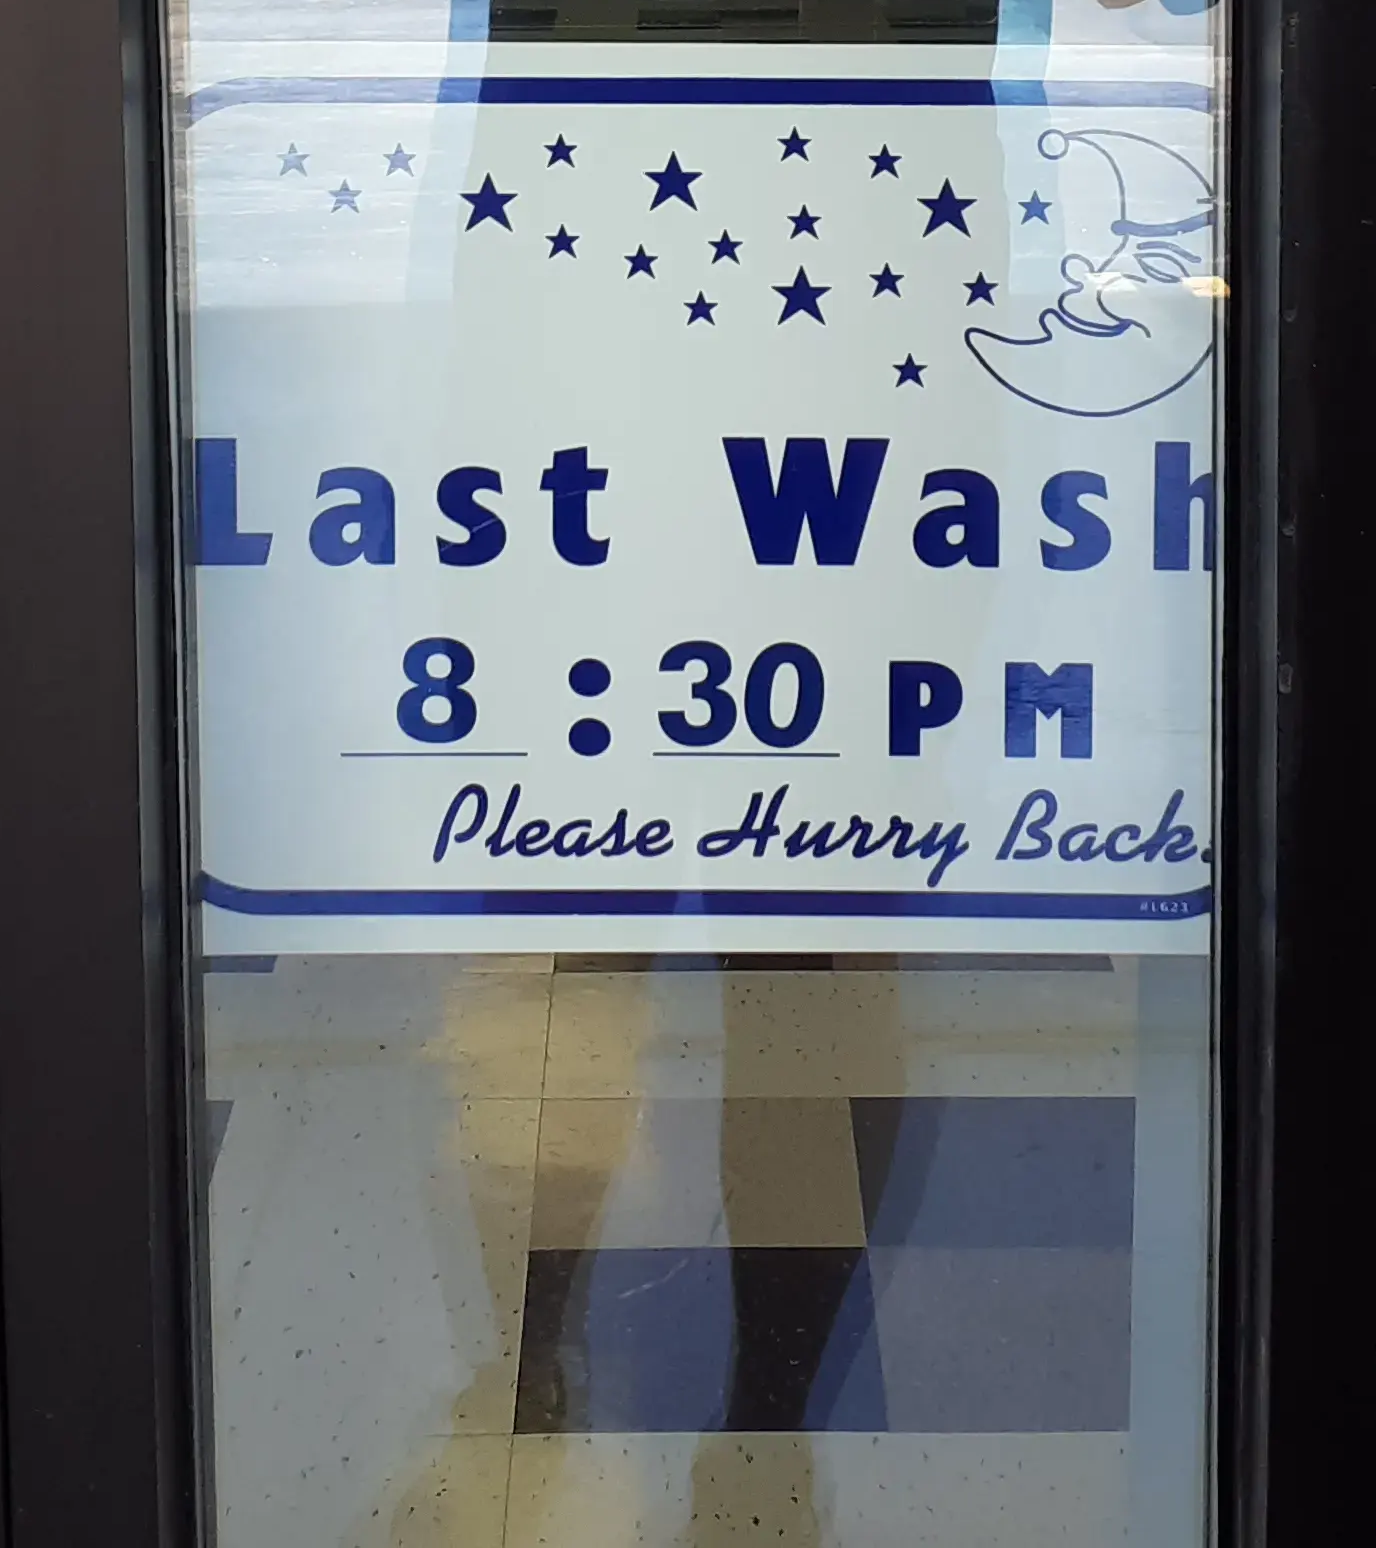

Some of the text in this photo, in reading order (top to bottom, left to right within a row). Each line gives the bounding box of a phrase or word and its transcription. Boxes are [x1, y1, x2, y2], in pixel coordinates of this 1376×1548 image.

[194, 435, 1212, 571] Last Wash
[432, 782, 675, 864] Please
[697, 783, 970, 888] Hurry
